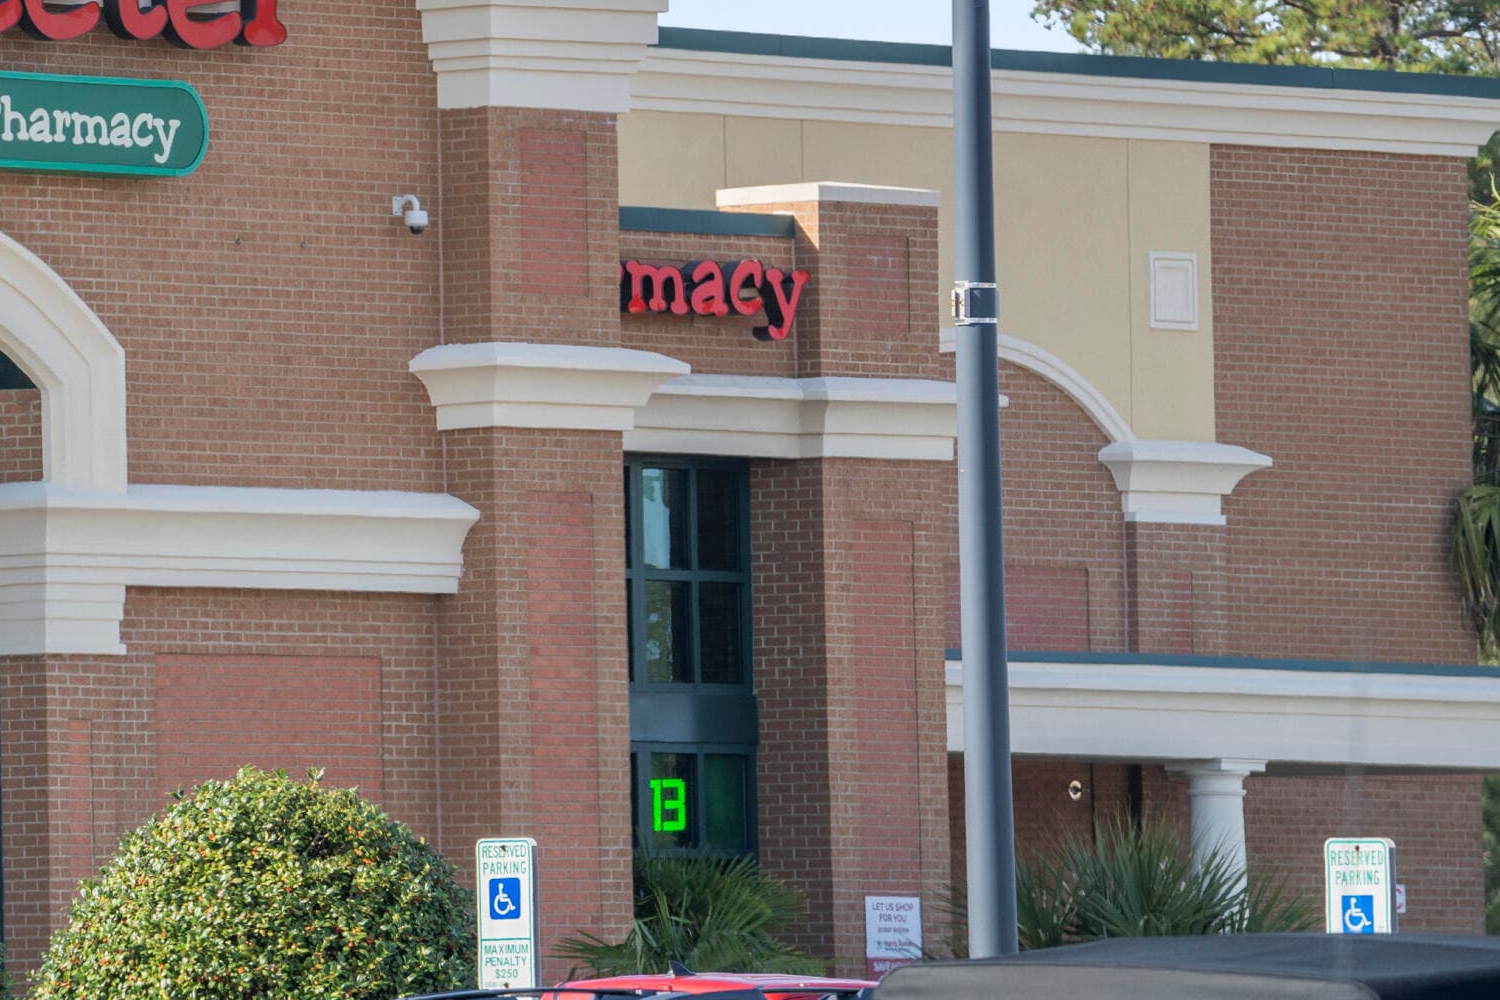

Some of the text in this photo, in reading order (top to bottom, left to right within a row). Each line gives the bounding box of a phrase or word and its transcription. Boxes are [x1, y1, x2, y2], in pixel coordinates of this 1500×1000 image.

[620, 258, 811, 341] macy
[482, 845, 527, 858] RESERVED
[1330, 850, 1384, 866] RESERVED
[482, 861, 527, 874] PARKING
[1335, 870, 1380, 886] PARKING
[484, 944, 529, 955] MAXIMUM
[485, 955, 527, 967] PENALTY
[495, 968, 518, 979] $250
